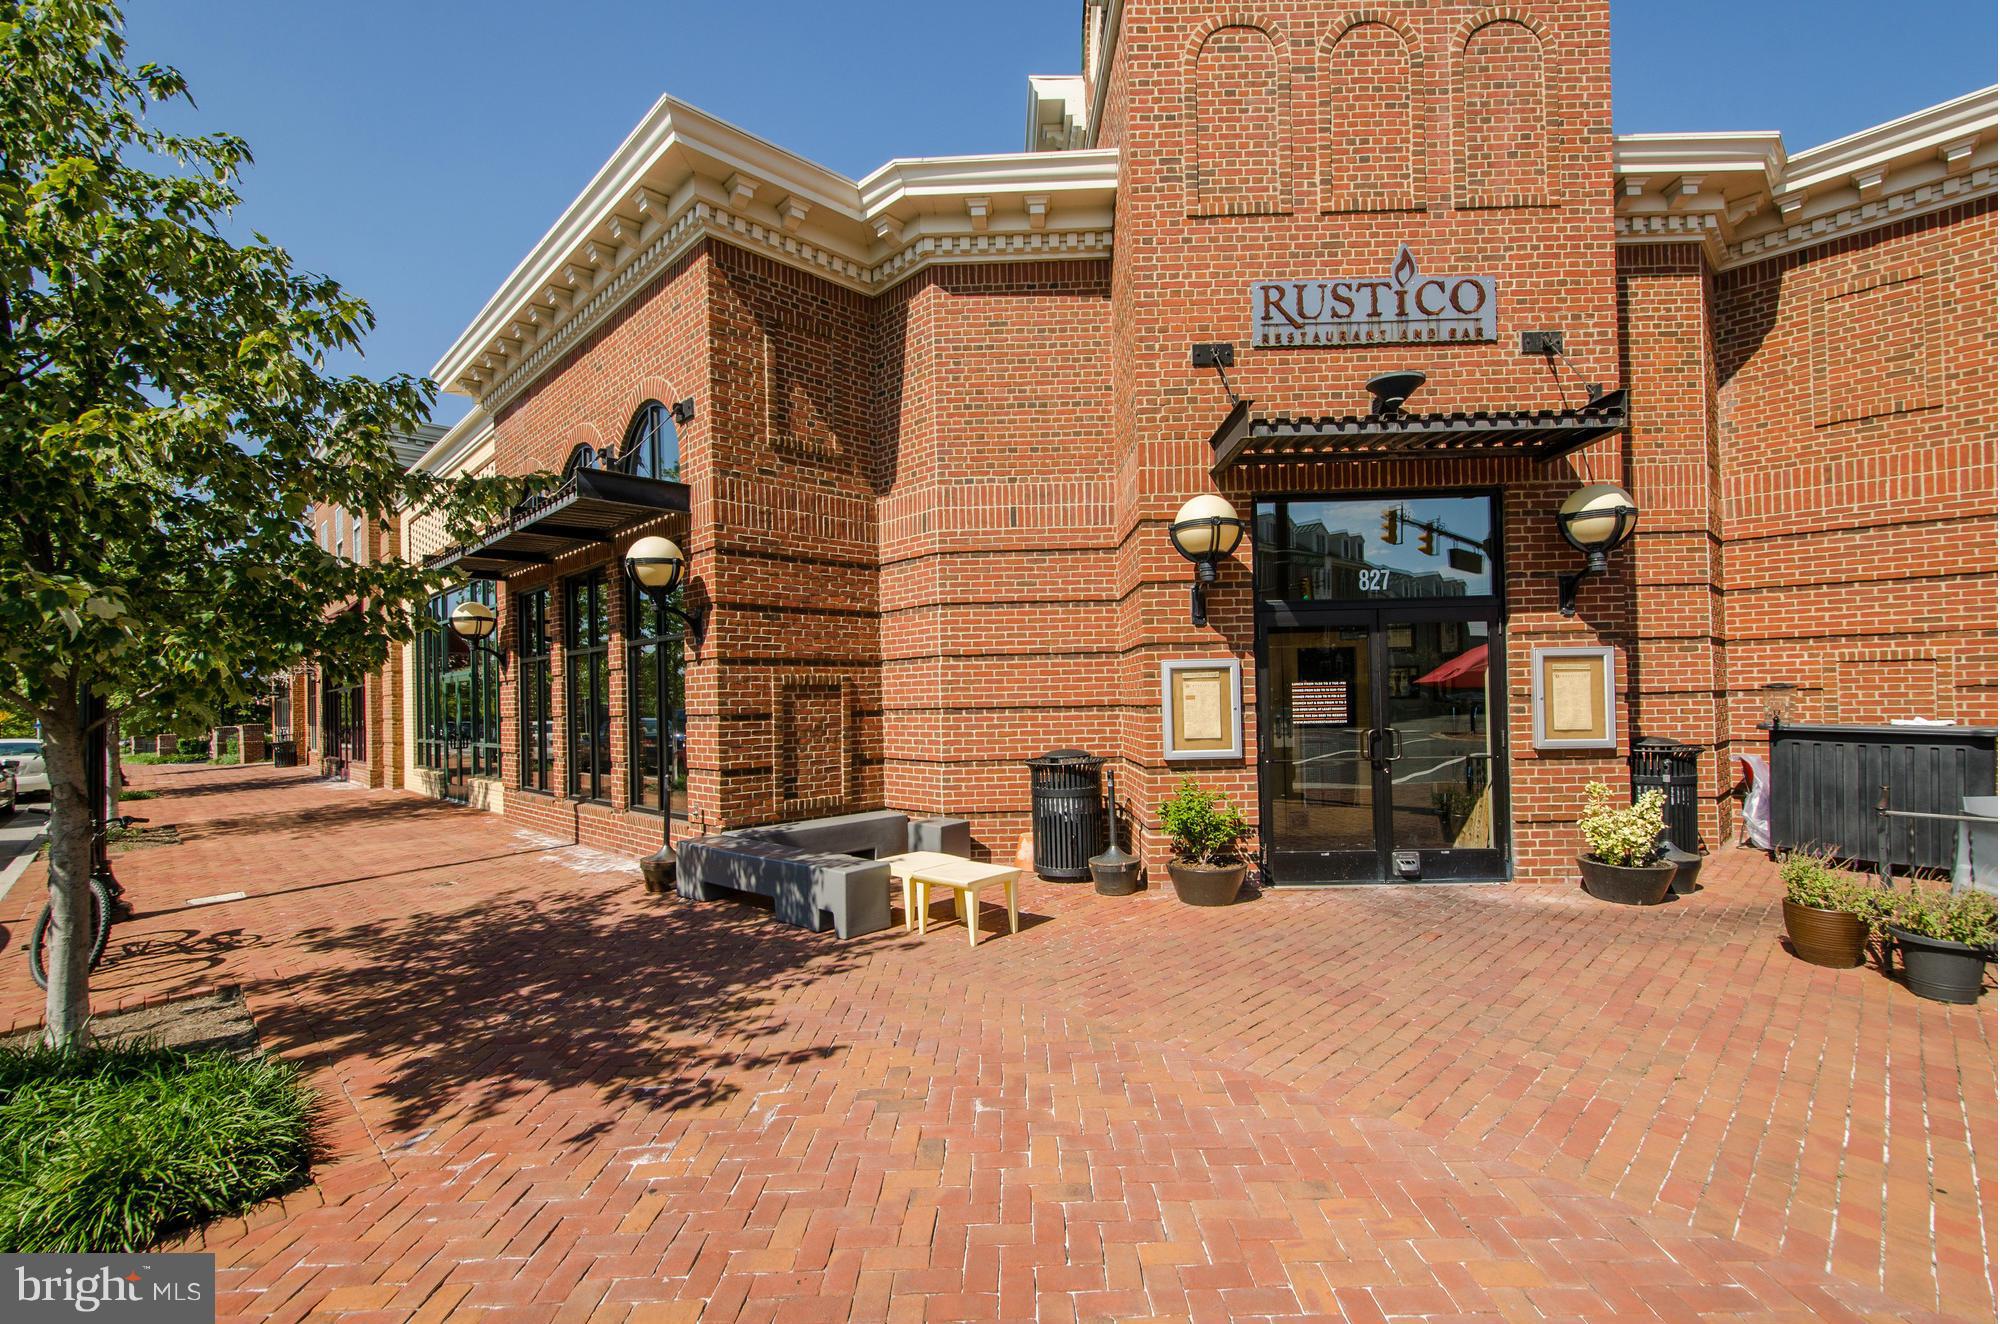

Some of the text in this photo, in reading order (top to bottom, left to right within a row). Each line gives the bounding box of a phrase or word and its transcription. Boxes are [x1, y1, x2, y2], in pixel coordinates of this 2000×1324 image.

[1259, 279, 1486, 329] RUSTICO
[1261, 326, 1484, 345] RESTAURANT AND BAR
[1358, 569, 1390, 591] 827
